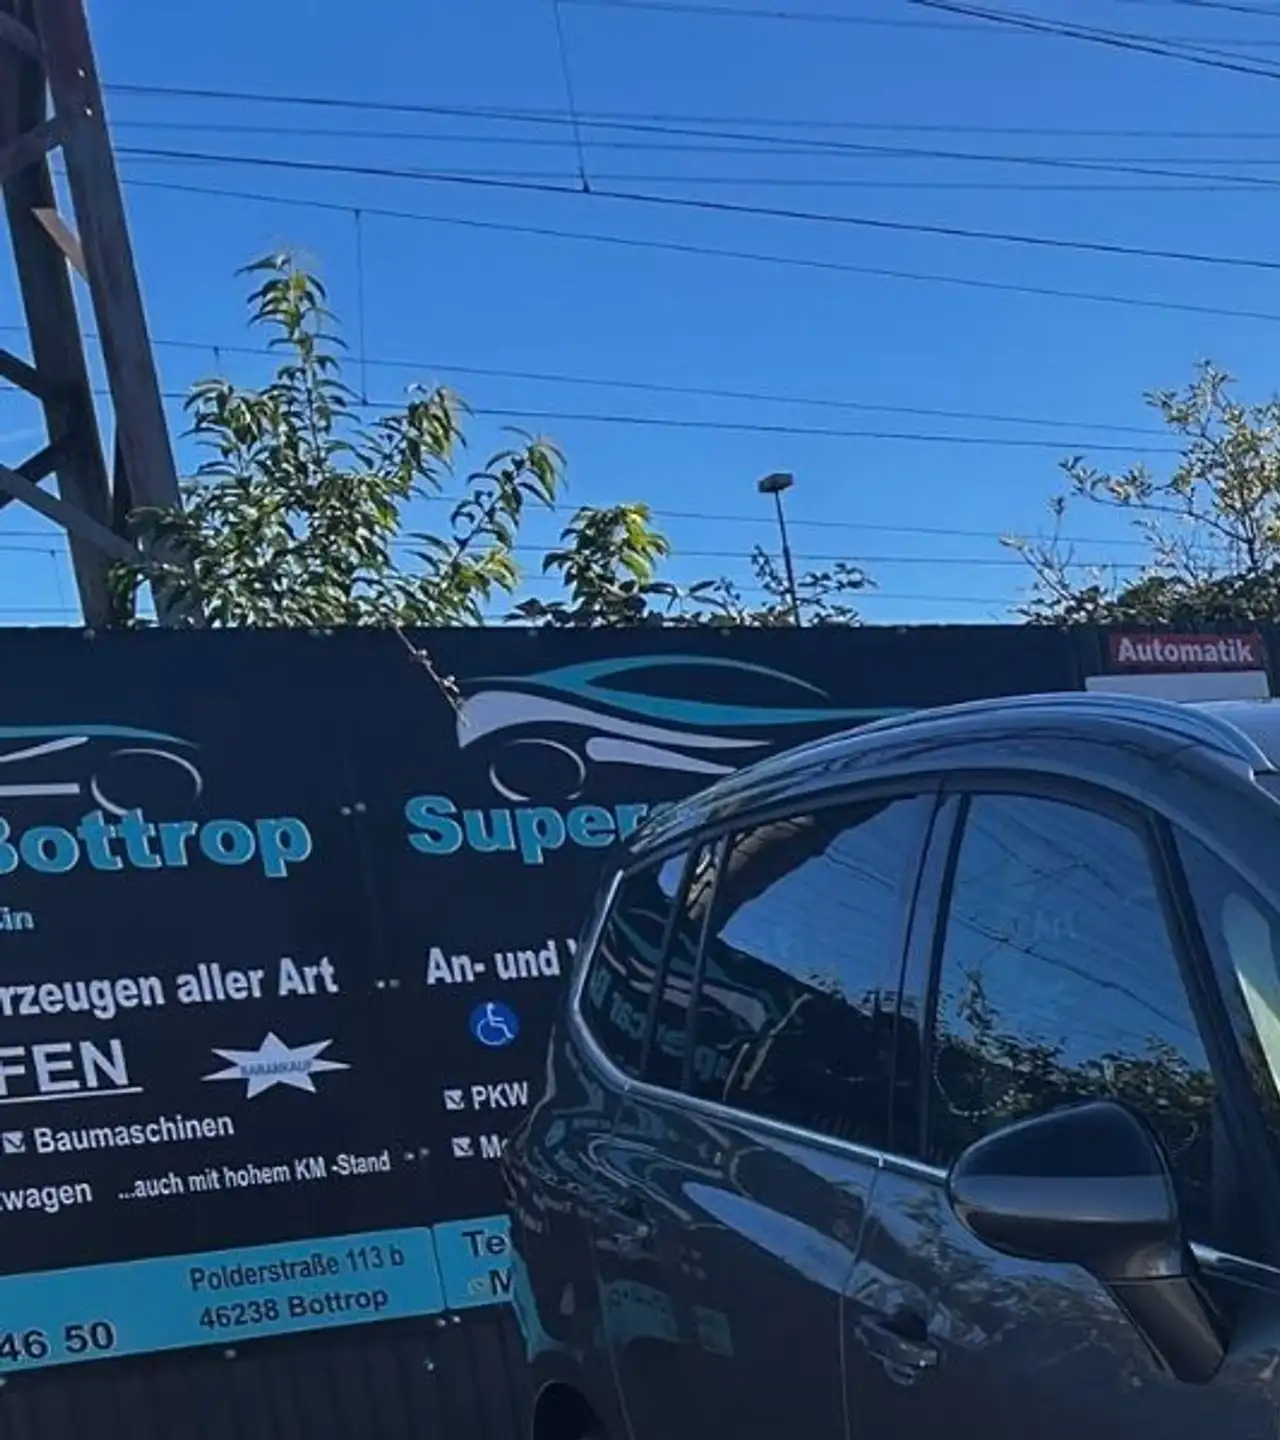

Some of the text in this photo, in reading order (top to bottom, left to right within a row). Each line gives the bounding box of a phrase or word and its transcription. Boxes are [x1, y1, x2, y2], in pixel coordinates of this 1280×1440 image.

[1118, 637, 1253, 662] Automatik
[176, 962, 264, 1004] aller
[278, 956, 339, 996] Art
[427, 947, 486, 985] An-
[494, 939, 560, 980] und
[471, 1080, 528, 1110] PKW
[33, 1114, 235, 1153] Baumaschinen
[188, 1168, 221, 1191] mit
[225, 1162, 291, 1189] hohem
[295, 1158, 327, 1180] KM
[332, 1150, 391, 1176] -Stand
[0, 1182, 93, 1213] wagen
[190, 1244, 404, 1291] Polderstraße 113 b
[199, 1287, 389, 1329] 46238 Bottrop
[64, 1320, 115, 1353] 50
